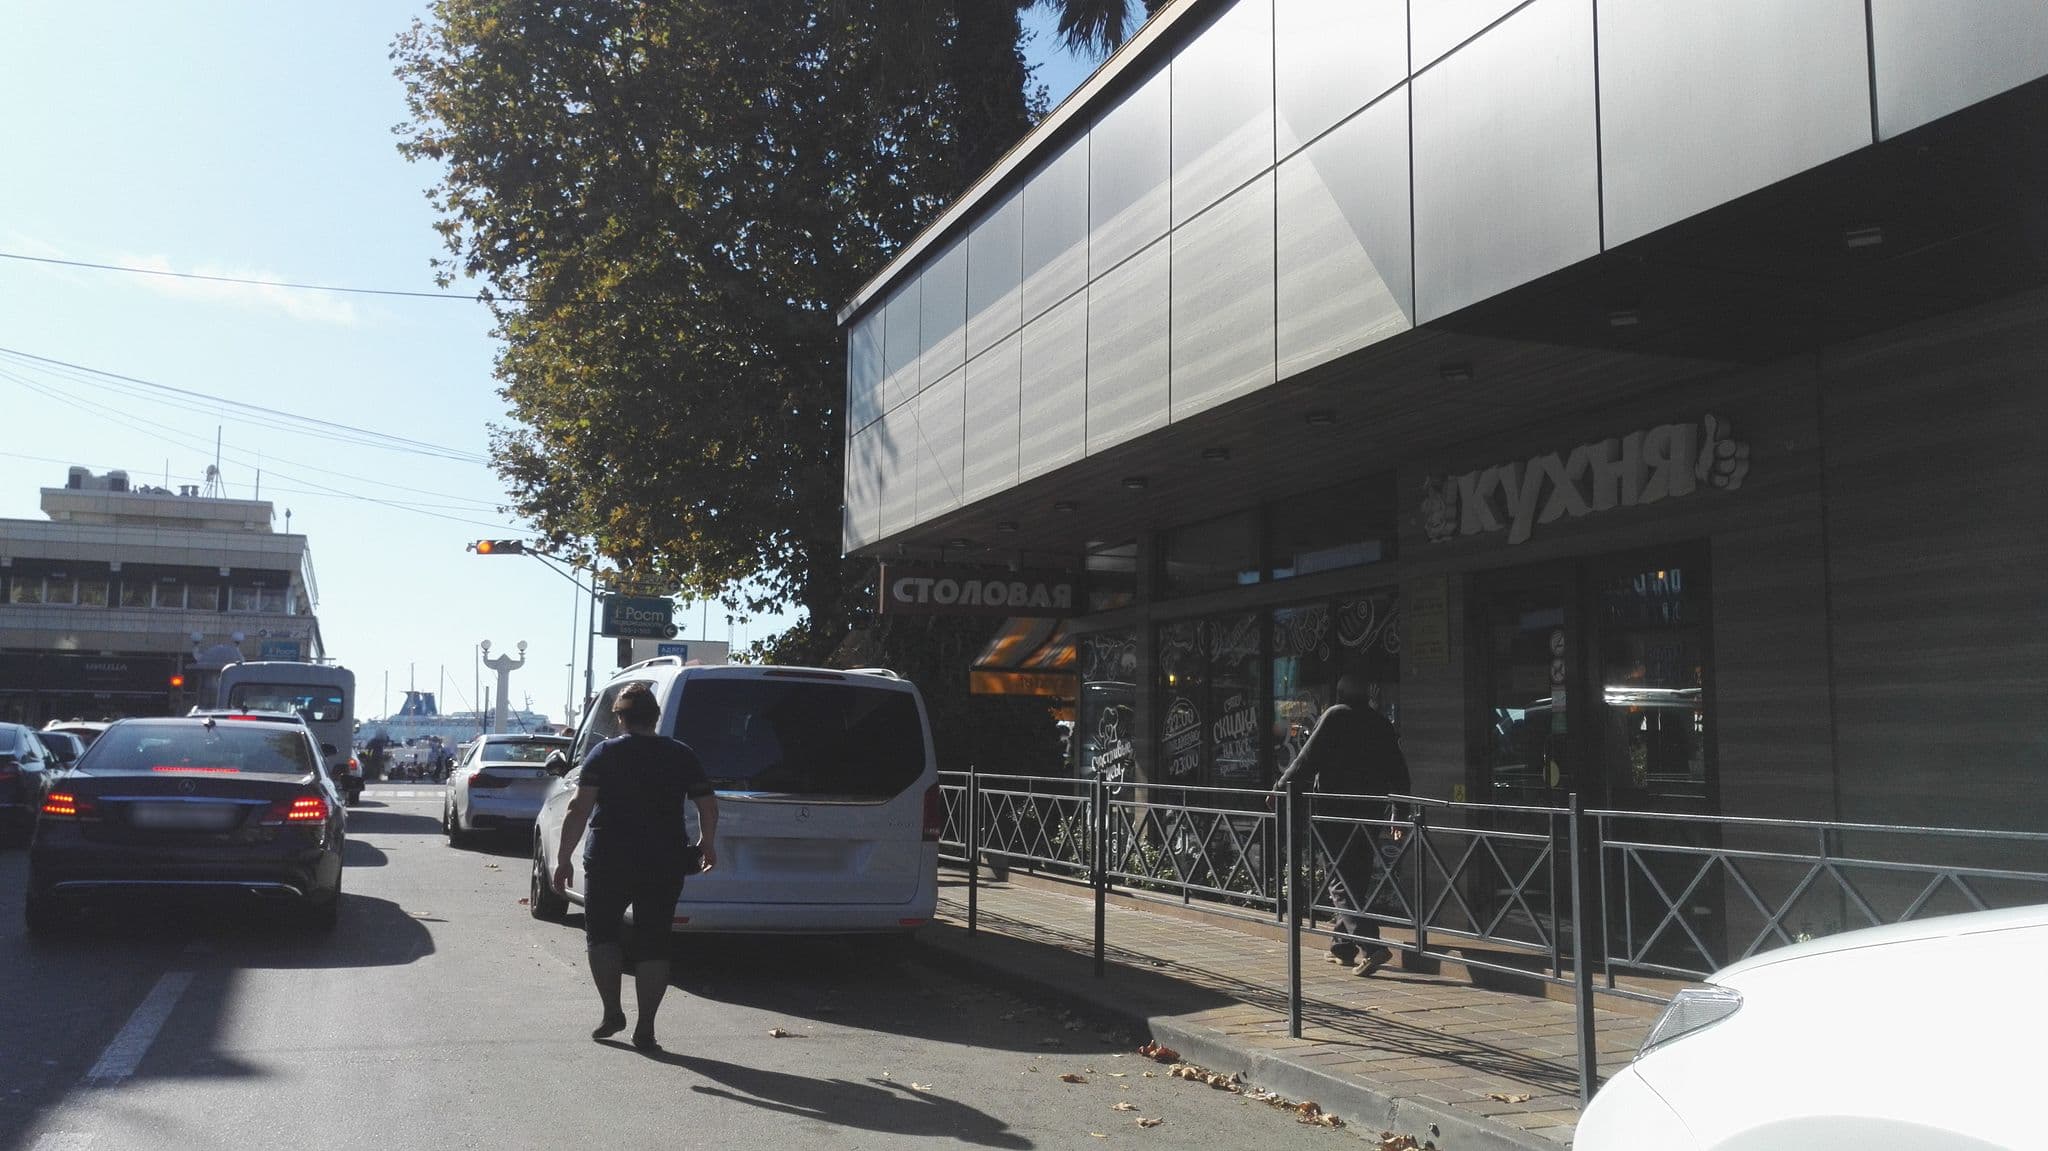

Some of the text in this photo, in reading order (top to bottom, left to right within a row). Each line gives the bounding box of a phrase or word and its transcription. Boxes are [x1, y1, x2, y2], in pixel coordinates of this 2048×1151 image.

[1457, 422, 1699, 545] КУХНЯ
[892, 576, 1072, 609] СТОЛОВАЯ
[1213, 706, 1257, 744] СКИДКА
